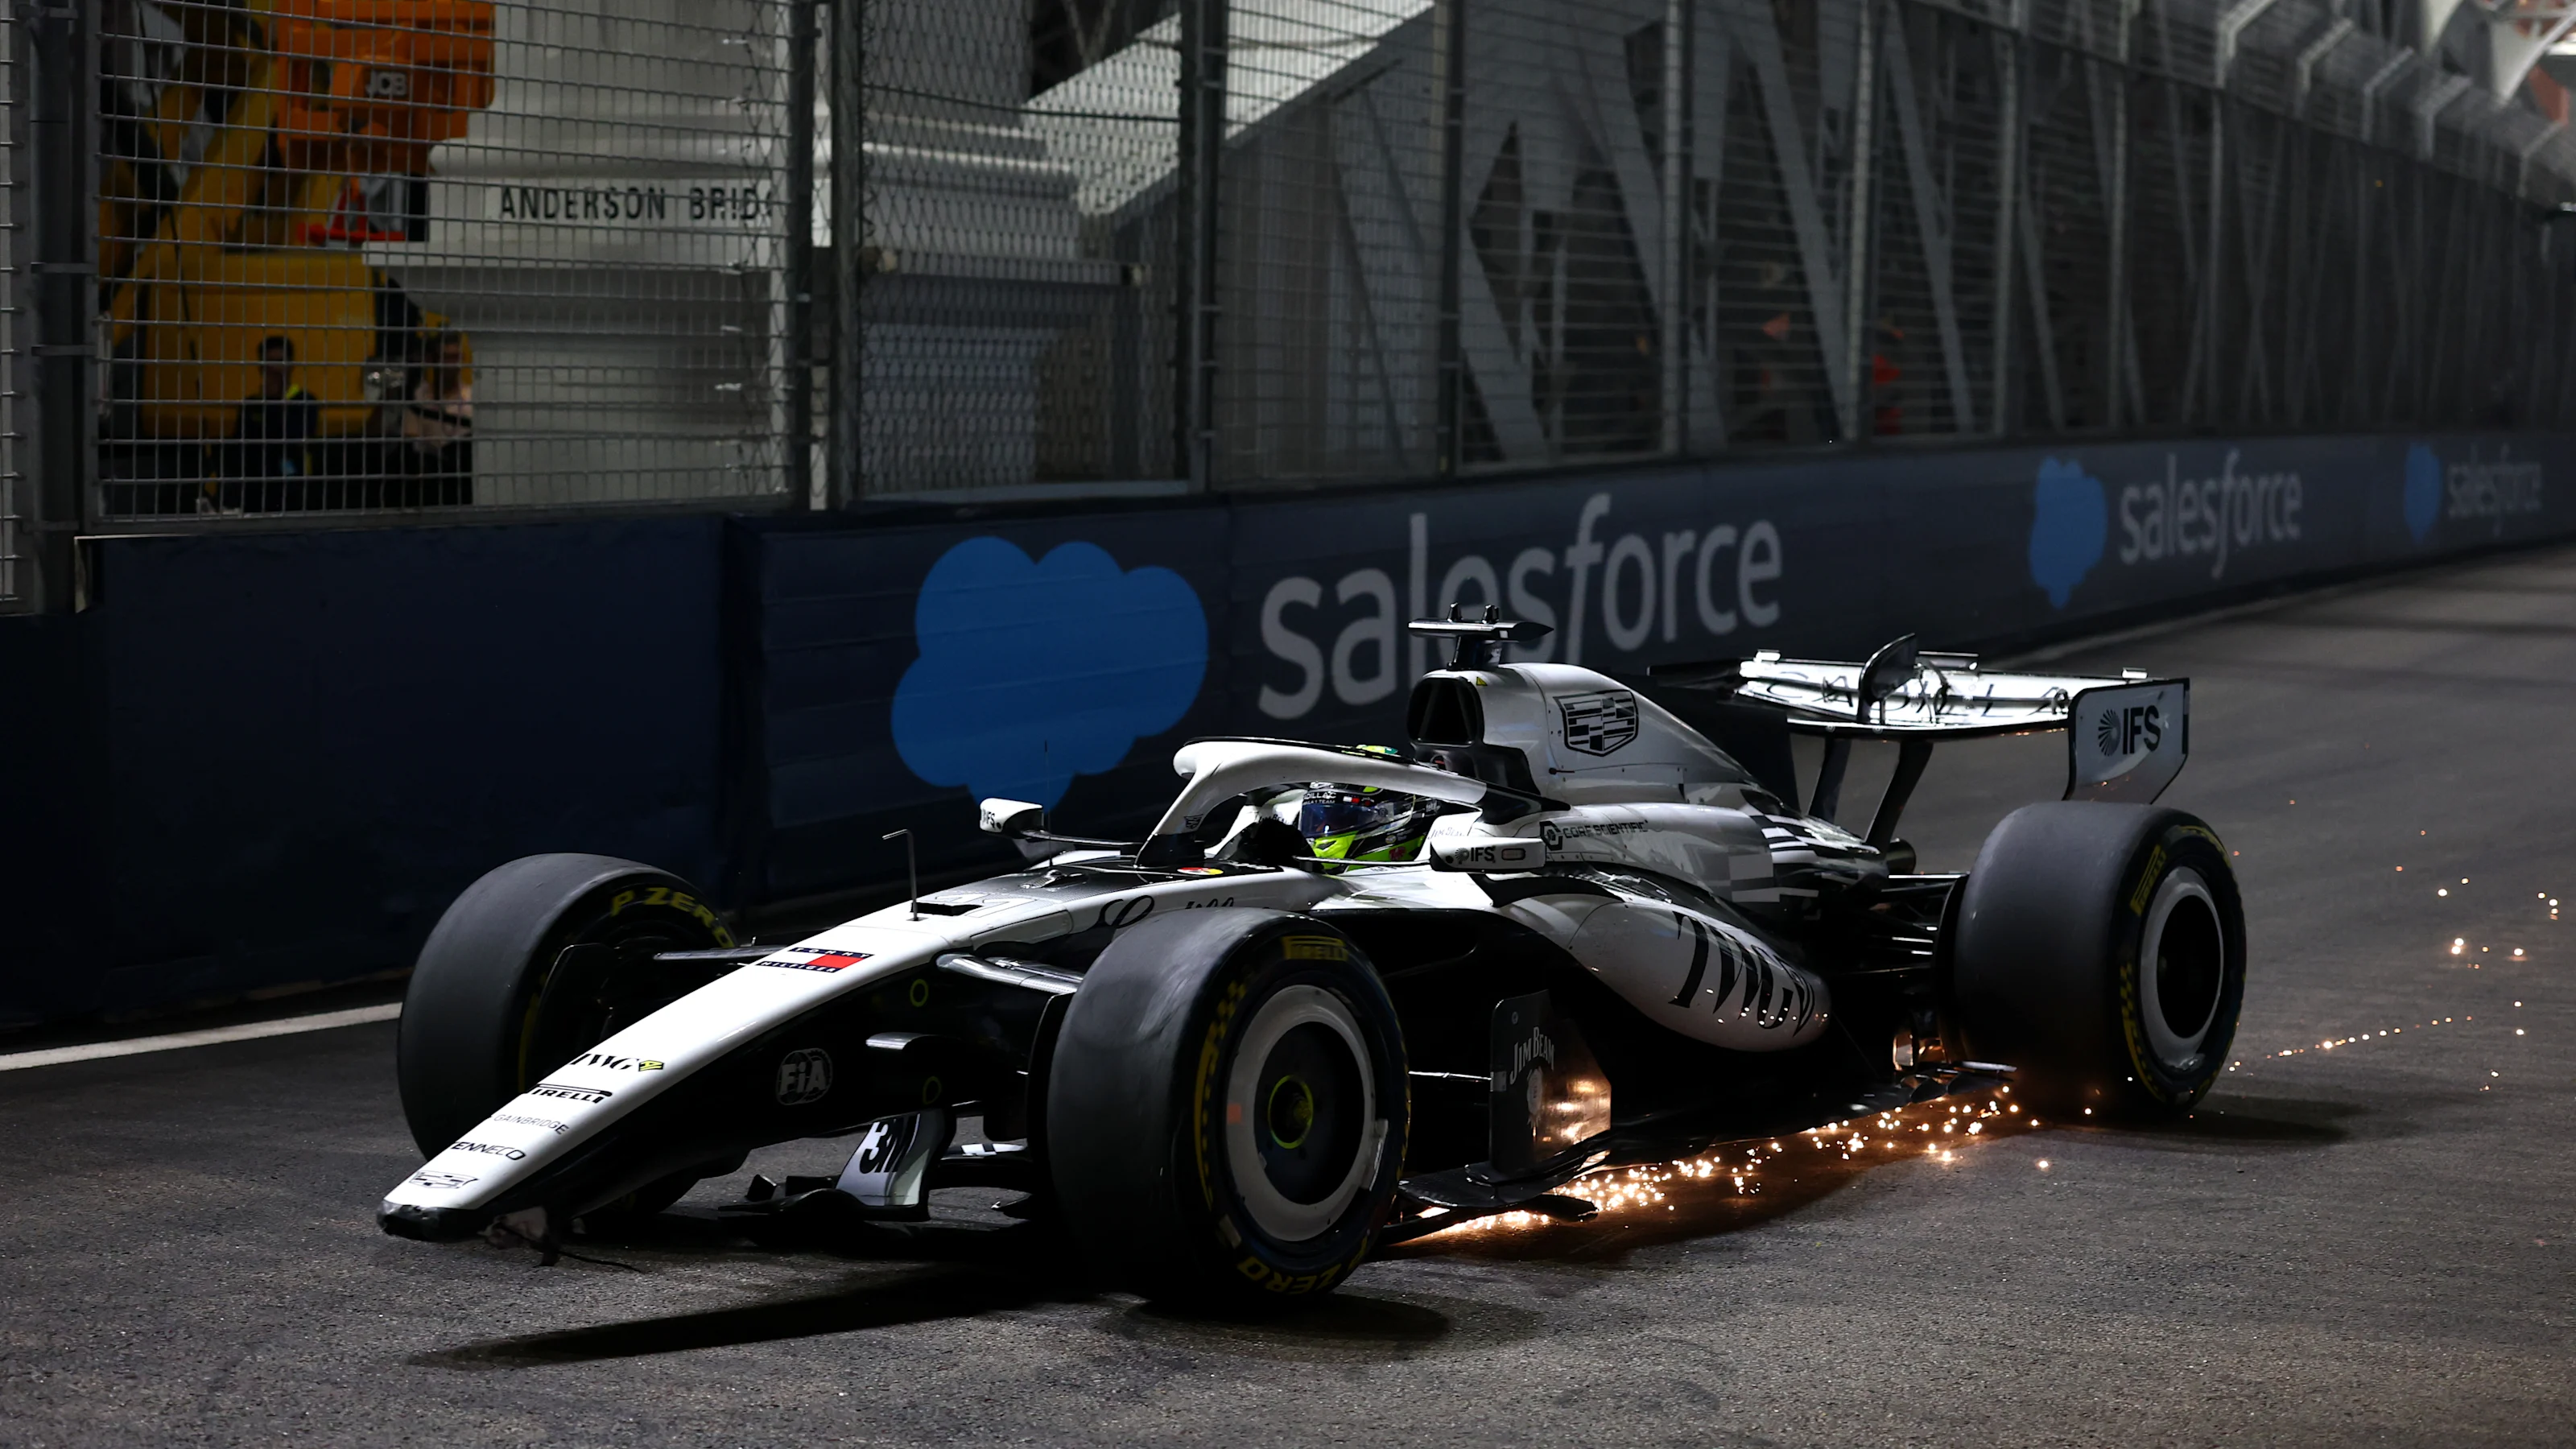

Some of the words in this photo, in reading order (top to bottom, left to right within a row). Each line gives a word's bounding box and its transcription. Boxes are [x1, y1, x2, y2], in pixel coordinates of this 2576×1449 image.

[365, 71, 407, 96] JCB
[501, 186, 666, 220] ANDERSON
[2120, 448, 2302, 580] salesforce
[1258, 493, 1782, 719] salesforce
[2122, 704, 2161, 756] IFS
[1563, 825, 1591, 839] CORE
[1592, 821, 1649, 836] SCIENTIFIC
[1471, 846, 1496, 863] IFS
[609, 890, 636, 918] P
[644, 887, 736, 948] ZERO
[795, 947, 872, 960] TOMMY
[759, 960, 837, 973] HILFIGER
[1509, 1037, 1533, 1086] JIM
[1532, 1026, 1555, 1073] BEAM
[523, 1083, 613, 1104] PIRELLI
[493, 1113, 570, 1135] GAINBRIDGE
[451, 1141, 526, 1161] ENNECO
[1236, 1256, 1344, 1296] ZERO
